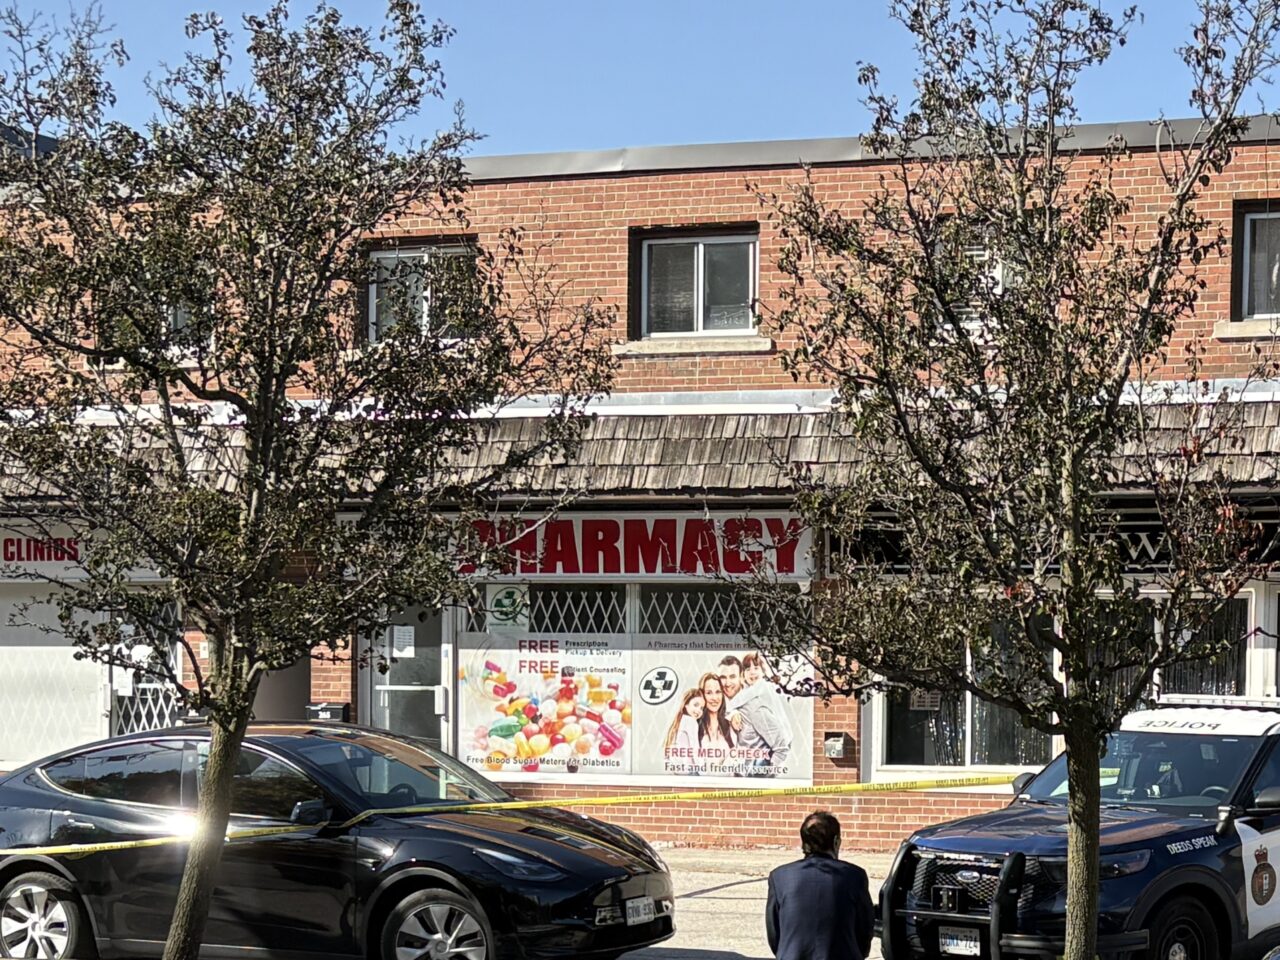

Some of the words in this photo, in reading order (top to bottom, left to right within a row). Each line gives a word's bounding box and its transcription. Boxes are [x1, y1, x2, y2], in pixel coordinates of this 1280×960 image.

[3, 537, 79, 562] CLINICS
[459, 518, 802, 574] PHARMACY
[519, 640, 559, 653] FREE
[565, 640, 608, 648] Prescriptions
[654, 641, 688, 649] Pharmacy
[705, 641, 733, 649] believes
[519, 660, 559, 674] FREE
[664, 747, 693, 758] FREE
[698, 748, 726, 758] MEDI
[729, 749, 770, 759] CHECK
[466, 756, 485, 764] Free
[487, 756, 511, 764] Blood
[513, 756, 537, 766] Sugar
[539, 757, 566, 765] Meters
[582, 758, 620, 767] Diabetics
[665, 762, 685, 771] Fast
[688, 762, 707, 772] and
[710, 762, 750, 775] friendly
[1166, 840, 1194, 855] DEEDS
[1191, 835, 1218, 850] SPEAK
